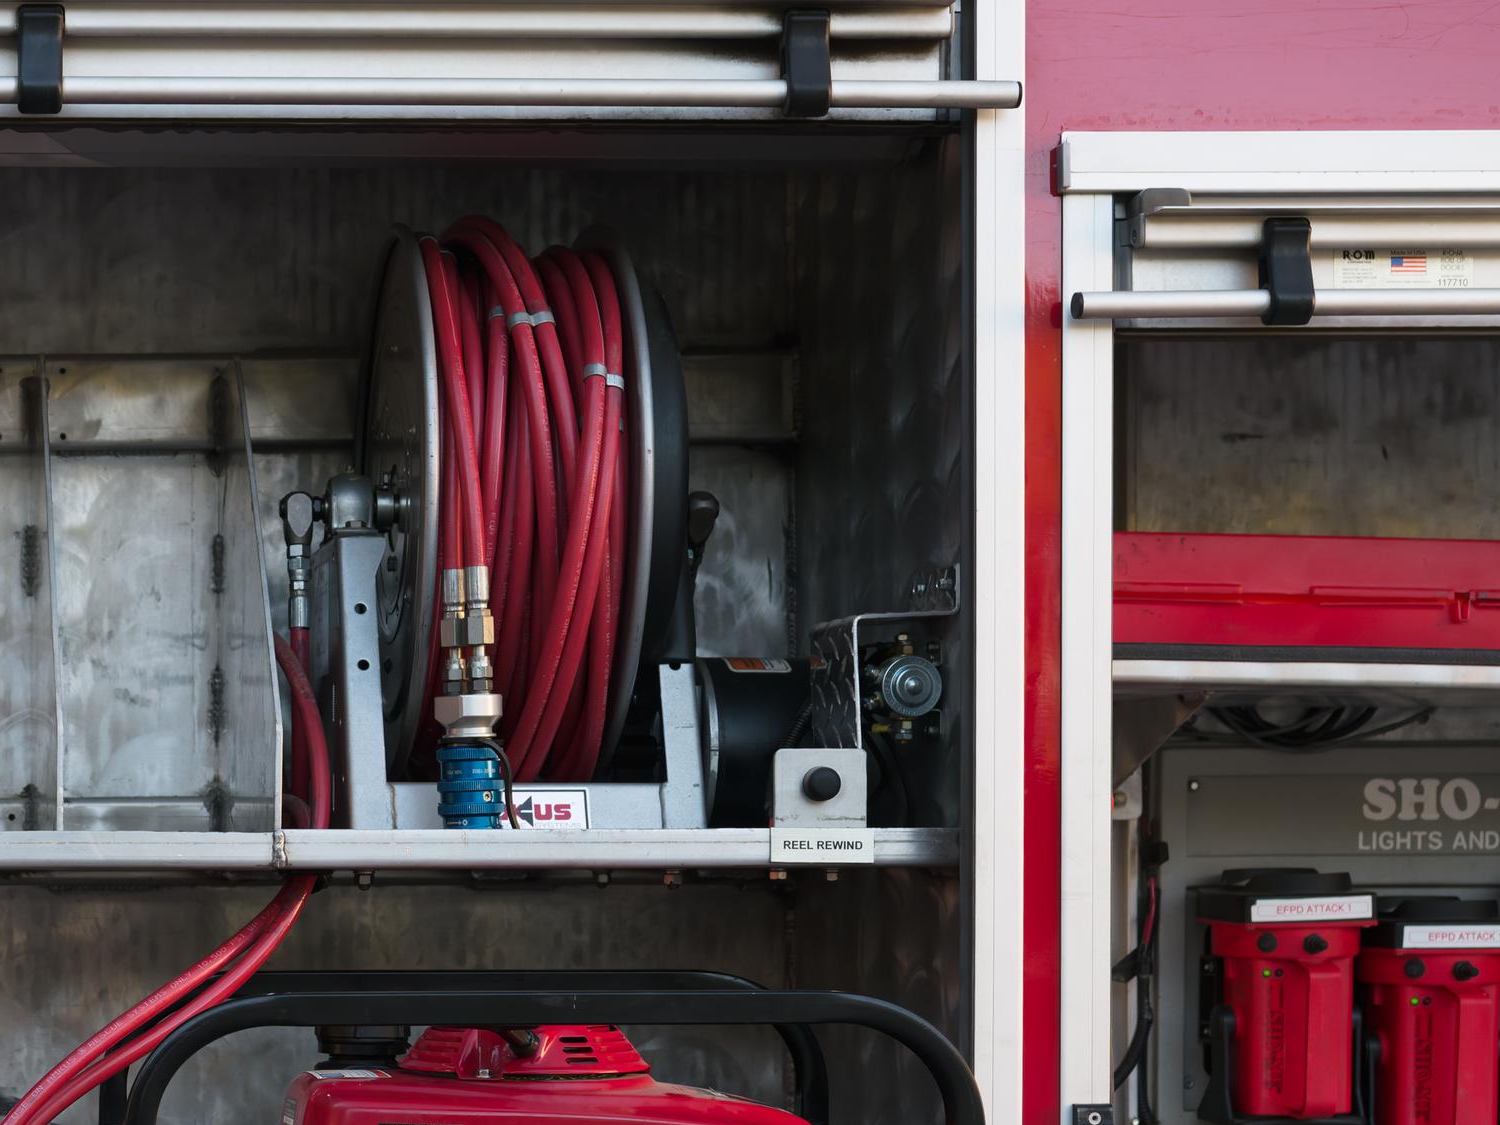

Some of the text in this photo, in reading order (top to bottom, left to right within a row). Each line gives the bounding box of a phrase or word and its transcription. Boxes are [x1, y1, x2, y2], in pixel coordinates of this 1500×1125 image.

[1437, 278, 1468, 287] 117710
[1362, 777, 1500, 821] SHO-
[783, 840, 863, 850] REEL REWIND
[1358, 830, 1500, 851] LIGHTS AND
[1276, 903, 1304, 915] EFPD
[1306, 902, 1344, 914] ATTACK
[1428, 931, 1496, 942] EFPD ATTACK
[126, 991, 166, 1018] SYSTEMS
[170, 972, 192, 989] ONLY
